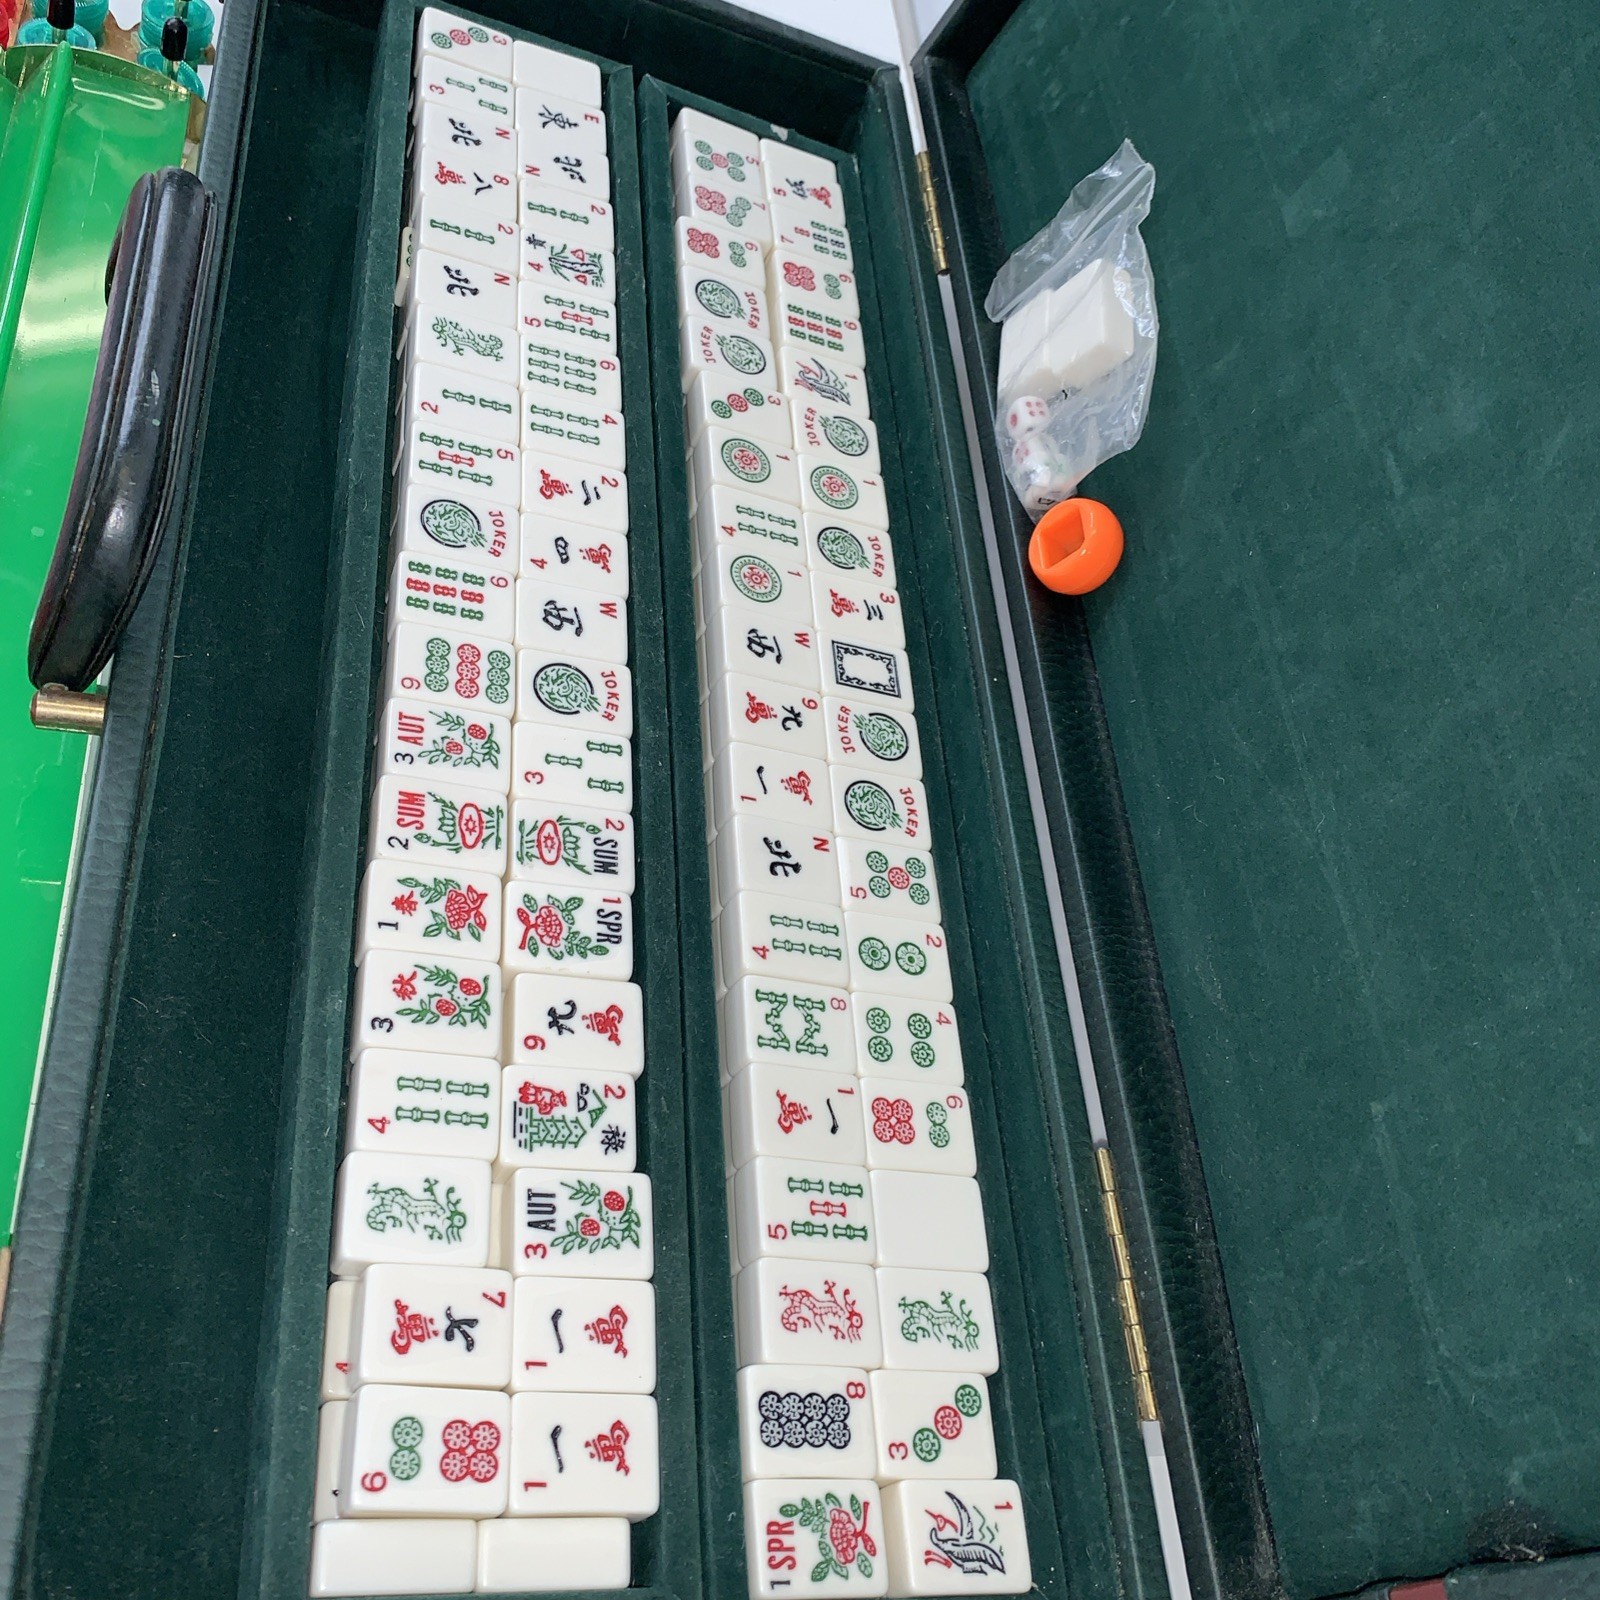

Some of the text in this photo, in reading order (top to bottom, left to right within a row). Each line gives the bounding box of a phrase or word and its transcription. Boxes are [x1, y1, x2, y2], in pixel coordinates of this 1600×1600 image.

[493, 34, 507, 45] 3
[429, 82, 444, 94] 3
[584, 114, 599, 124] E
[496, 128, 510, 139] N
[744, 156, 760, 166] 5
[526, 165, 540, 176] N
[492, 175, 509, 188] 8
[773, 187, 786, 197] 5
[591, 204, 606, 215] 2
[751, 202, 766, 211] 7
[498, 222, 513, 235] 2
[781, 235, 794, 244] 7
[528, 262, 543, 272] 4
[494, 273, 510, 286] N
[746, 293, 760, 329] JOKER
[525, 316, 541, 327] 5
[701, 326, 716, 363] JOKER
[768, 395, 781, 405] 3
[421, 402, 438, 414] 2
[602, 412, 618, 425] 4
[805, 408, 820, 446] JOKER
[497, 449, 514, 461] 5
[601, 476, 619, 488] 2
[488, 511, 506, 557] JOKER
[721, 523, 739, 537] 4
[530, 558, 547, 569] 4
[866, 536, 884, 577] JOKER
[878, 591, 895, 604] 3
[600, 603, 617, 619] W
[794, 633, 810, 648] W
[599, 671, 619, 721] JOKER
[838, 706, 858, 753] JOKER
[394, 712, 424, 764] 3 AUT
[524, 771, 544, 784] 3
[898, 787, 918, 837] JOKER
[388, 791, 425, 850] 2 SUM
[593, 818, 625, 875] 2 SUM
[813, 837, 829, 852] N
[850, 884, 869, 899] 5
[378, 922, 399, 930] 1
[595, 909, 622, 947] SPR
[926, 932, 942, 948] 2
[752, 946, 770, 960] 4
[830, 997, 846, 1011] 8
[371, 1017, 393, 1033] 3
[936, 1012, 952, 1025] 4
[604, 1084, 626, 1099] 2
[368, 1117, 390, 1134] 4
[524, 1188, 556, 1259] 3 AUT
[768, 1224, 788, 1240] 5
[482, 1292, 506, 1308] 7
[525, 1361, 547, 1370] 1
[847, 1382, 866, 1399] 8
[888, 1442, 908, 1460] 3
[523, 1482, 547, 1492] 1
[994, 1501, 1013, 1510] 1
[766, 1521, 796, 1590] 1 SPR
